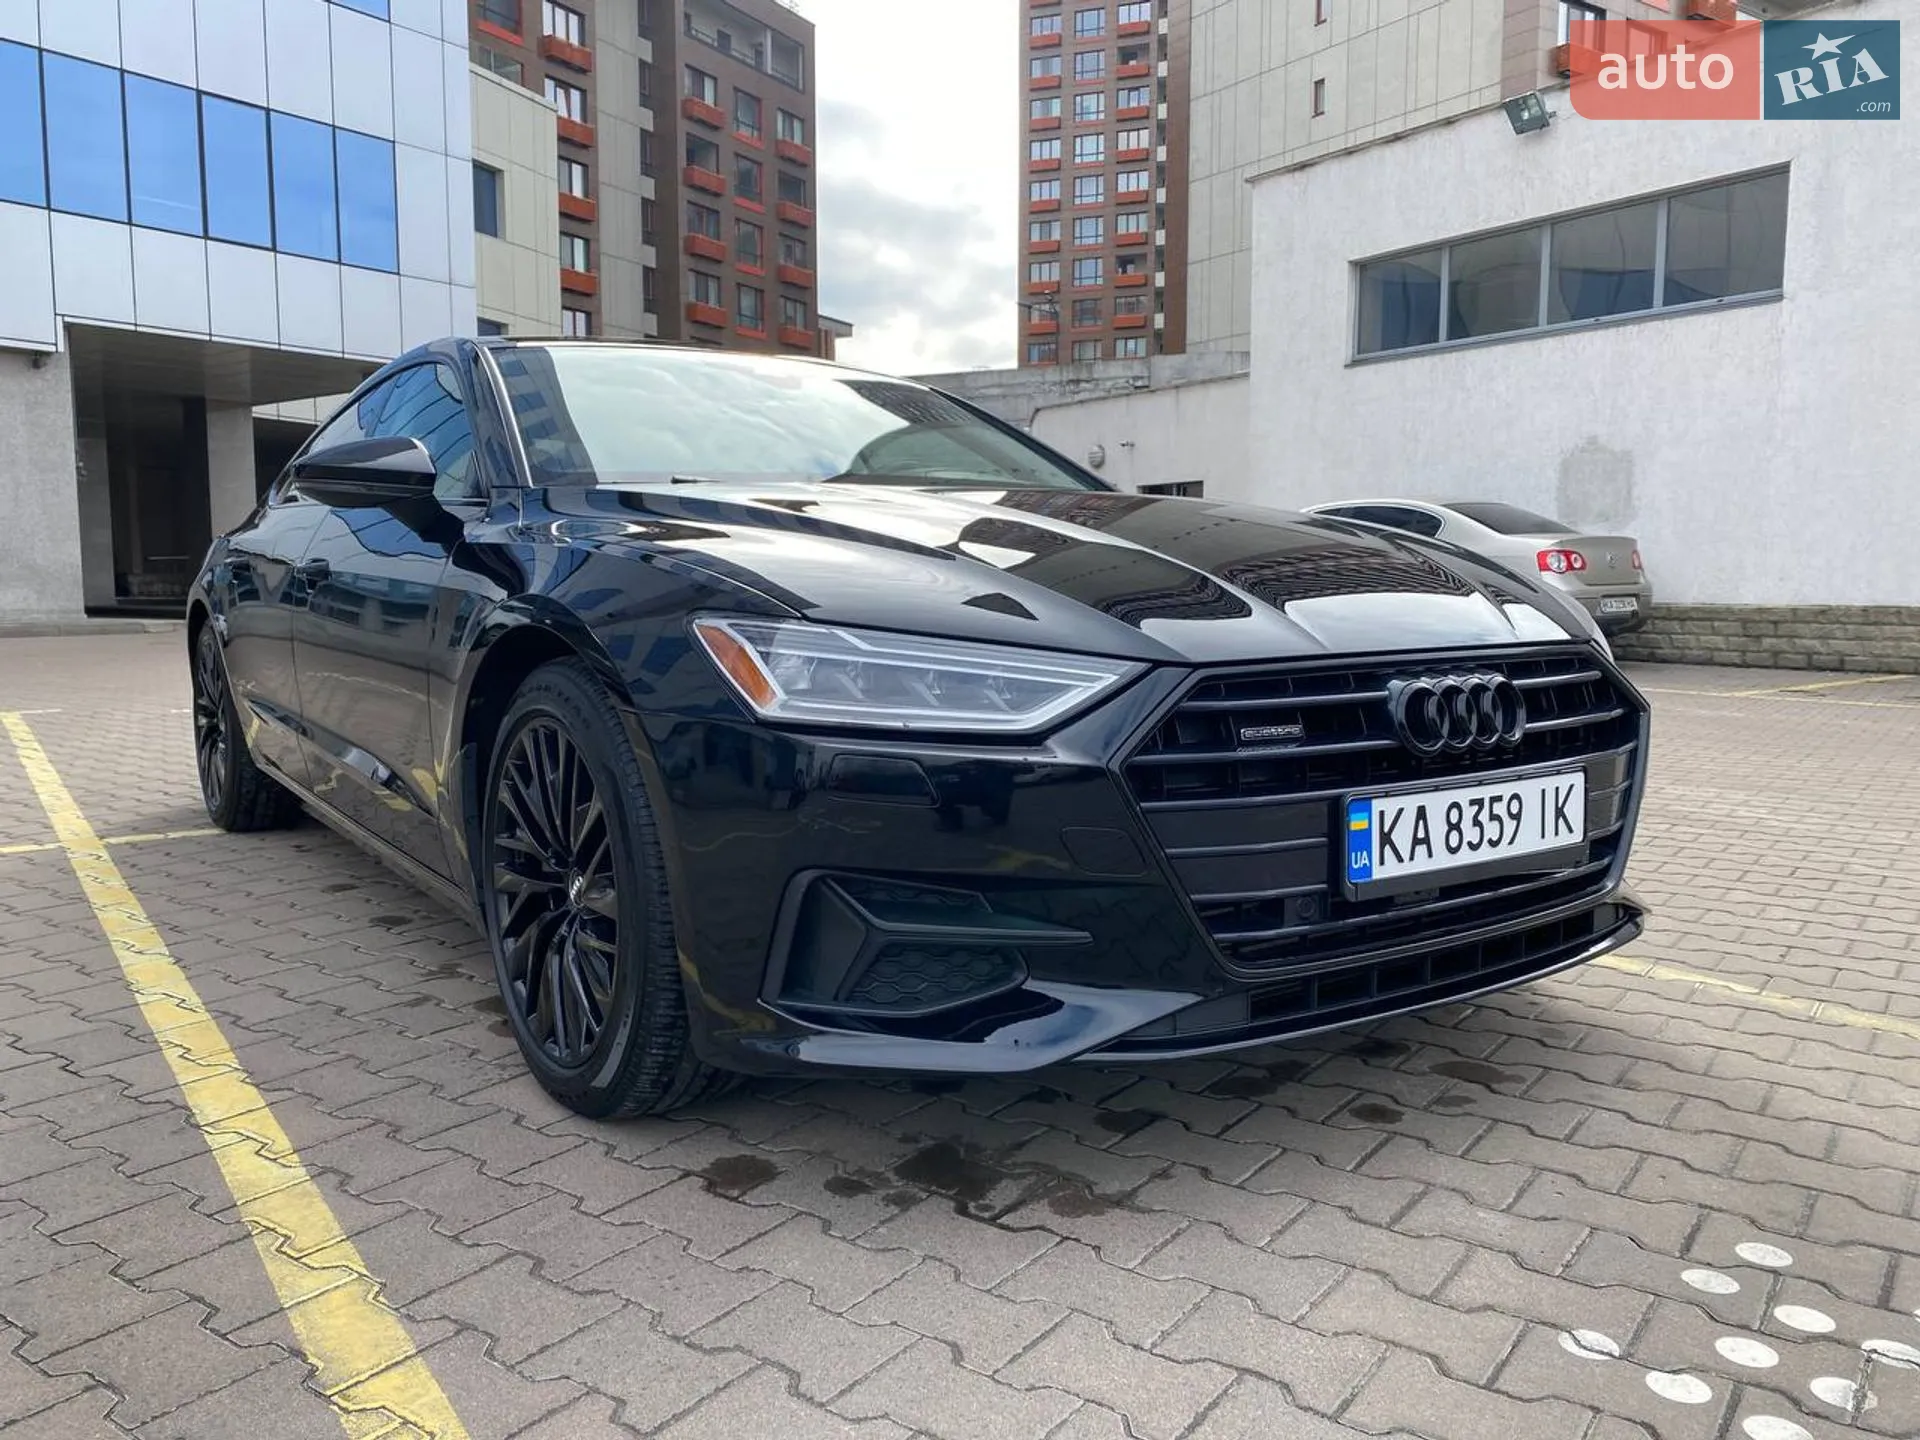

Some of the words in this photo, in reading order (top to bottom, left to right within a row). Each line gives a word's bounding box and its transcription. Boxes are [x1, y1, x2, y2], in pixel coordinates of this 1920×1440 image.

[1378, 804, 1434, 866] KA
[1444, 792, 1524, 855] 8359
[1540, 783, 1575, 840] IK
[1351, 852, 1371, 869] UA
